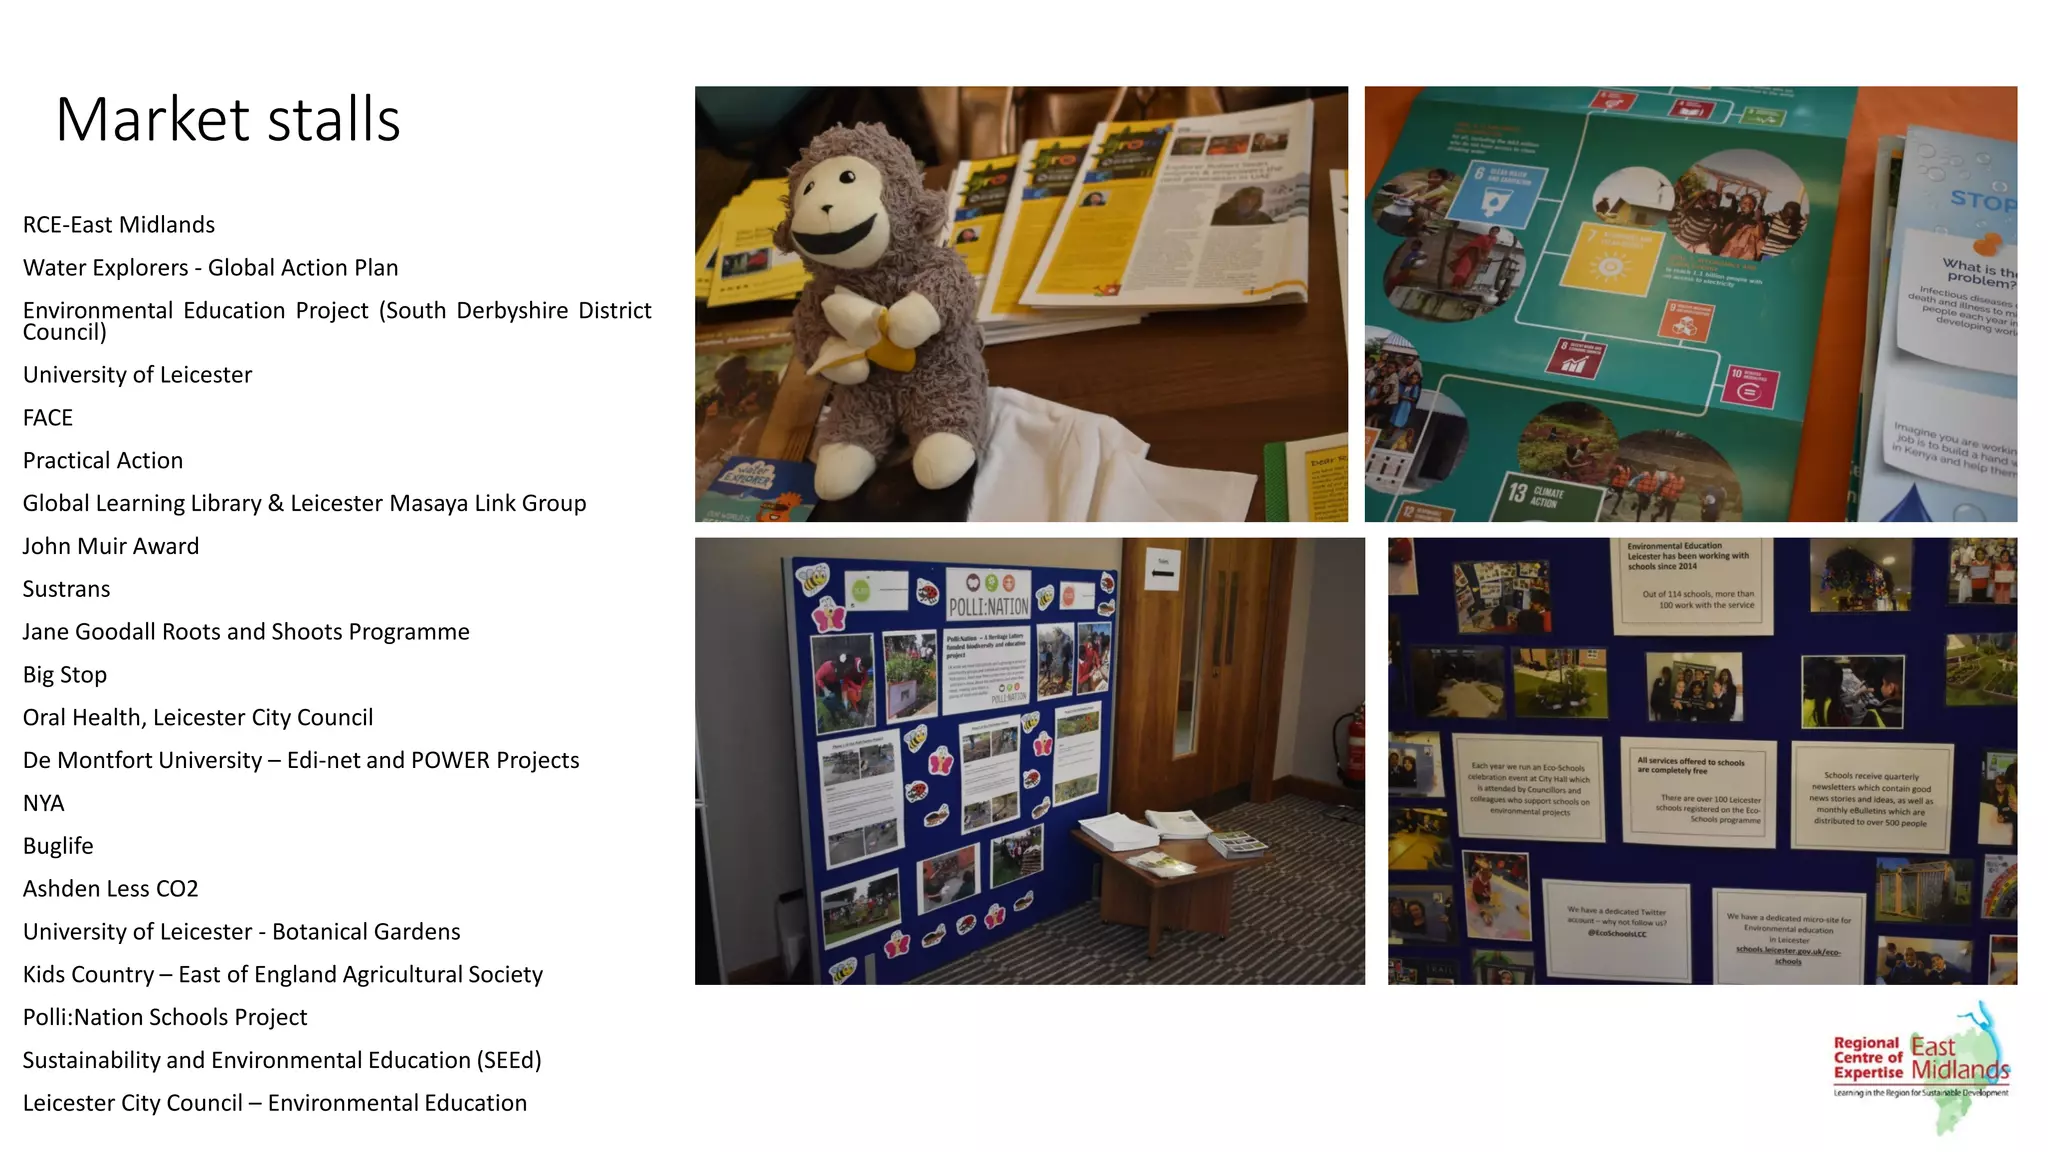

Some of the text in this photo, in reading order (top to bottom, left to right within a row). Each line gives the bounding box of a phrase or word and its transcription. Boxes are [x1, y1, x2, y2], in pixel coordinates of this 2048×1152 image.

[1942, 257, 2018, 278] What is th
[1948, 271, 2018, 290] problem?
[1920, 285, 2013, 308] Infectious diseases
[1908, 293, 2004, 316] death and illness to
[1731, 368, 1743, 378] 10
[1507, 482, 1528, 503] 13
[1533, 486, 1565, 499] CLIMATE
[1530, 497, 1558, 509] ACTION
[1403, 506, 1414, 518] 12
[1627, 541, 1723, 550] Environmental Education
[1628, 551, 1750, 561] Leicester has been working with
[1628, 563, 1656, 571] schools
[1678, 562, 1698, 570] 2014
[1642, 590, 1657, 598] Out
[1658, 590, 1667, 598] of
[1668, 590, 1682, 598] 114
[1683, 590, 1714, 599] schools,
[1737, 590, 1755, 598] than
[949, 597, 1029, 616] POLLI:NATION
[1660, 601, 1673, 609] 100
[1675, 601, 1694, 609] work
[1695, 601, 1712, 609] with
[1713, 601, 1727, 609] the
[1649, 757, 1678, 765] services
[1679, 757, 1707, 766] offered
[1717, 759, 1745, 767] schools
[1651, 767, 1692, 775] completely
[1693, 767, 1708, 775] free
[1588, 929, 1647, 938] @EcoSchoolsLCC
[1775, 958, 1802, 966] schools
